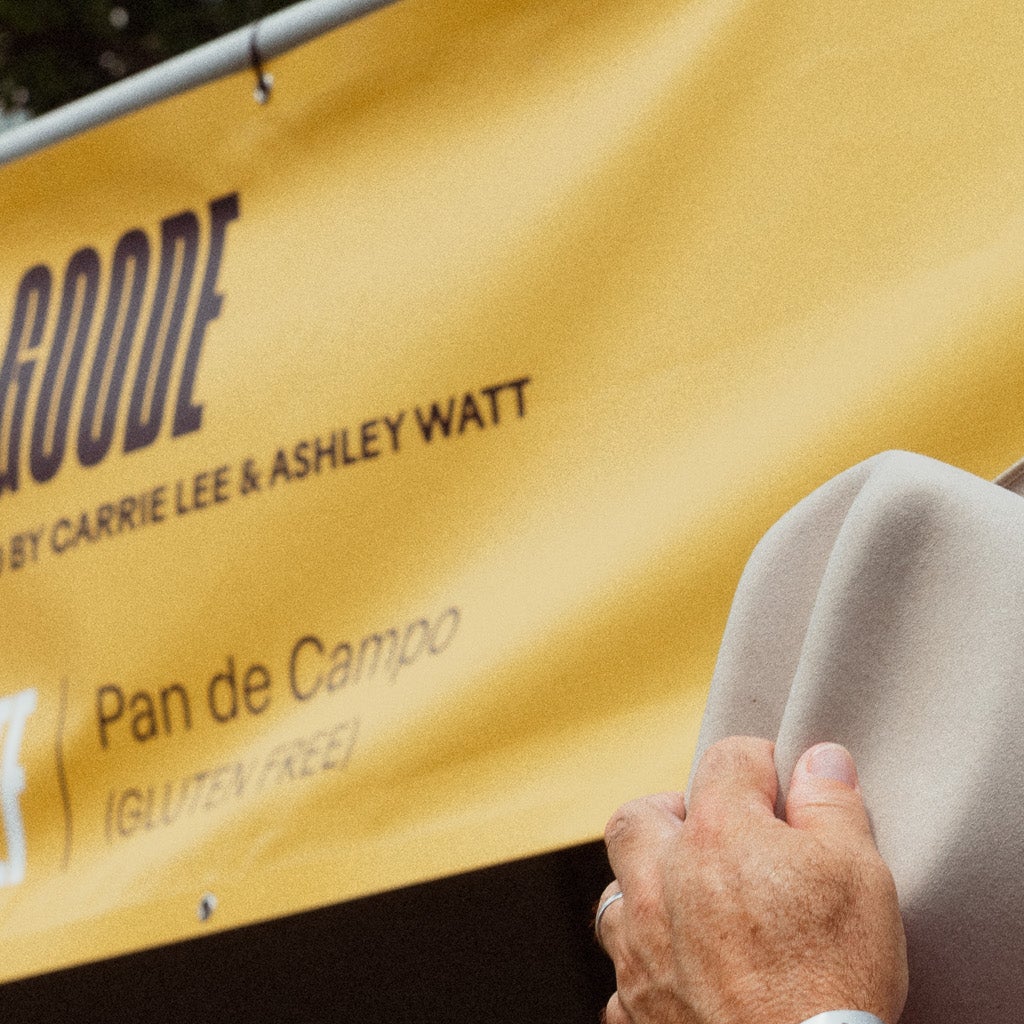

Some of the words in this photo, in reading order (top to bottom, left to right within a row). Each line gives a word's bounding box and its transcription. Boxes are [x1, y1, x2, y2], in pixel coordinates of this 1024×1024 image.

[0, 190, 240, 496] GOODE
[9, 526, 44, 570] BY
[51, 485, 166, 555] CARRIE
[175, 466, 231, 517] LEE
[239, 457, 260, 496] &
[268, 411, 405, 489] ASHLEY
[415, 377, 532, 443] WATT
[96, 684, 192, 749] Pan
[207, 656, 271, 724] de
[289, 605, 461, 702] Campo
